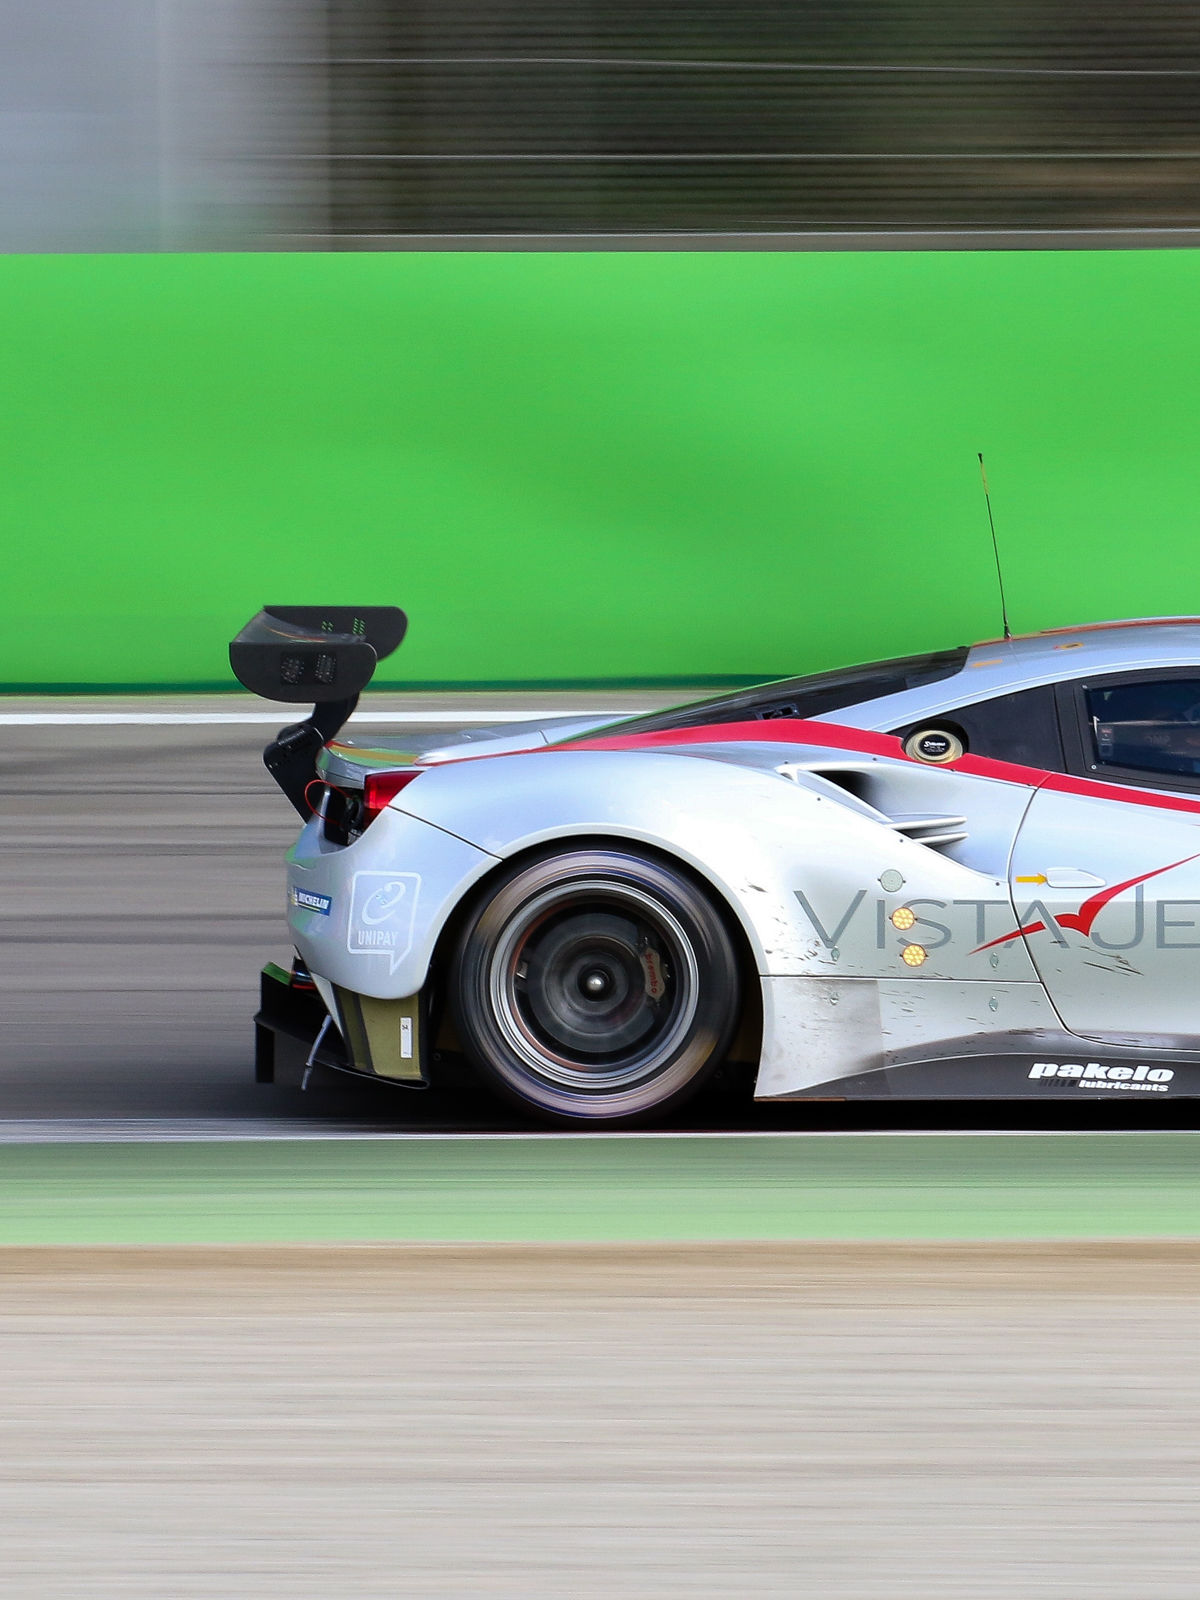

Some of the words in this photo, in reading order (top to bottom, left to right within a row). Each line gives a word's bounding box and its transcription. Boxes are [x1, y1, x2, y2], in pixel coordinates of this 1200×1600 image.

[298, 892, 330, 910] MICHELIN
[358, 930, 399, 946] UNIPAY
[1028, 1062, 1175, 1083] pakelo
[1078, 1079, 1170, 1093] lubricants
